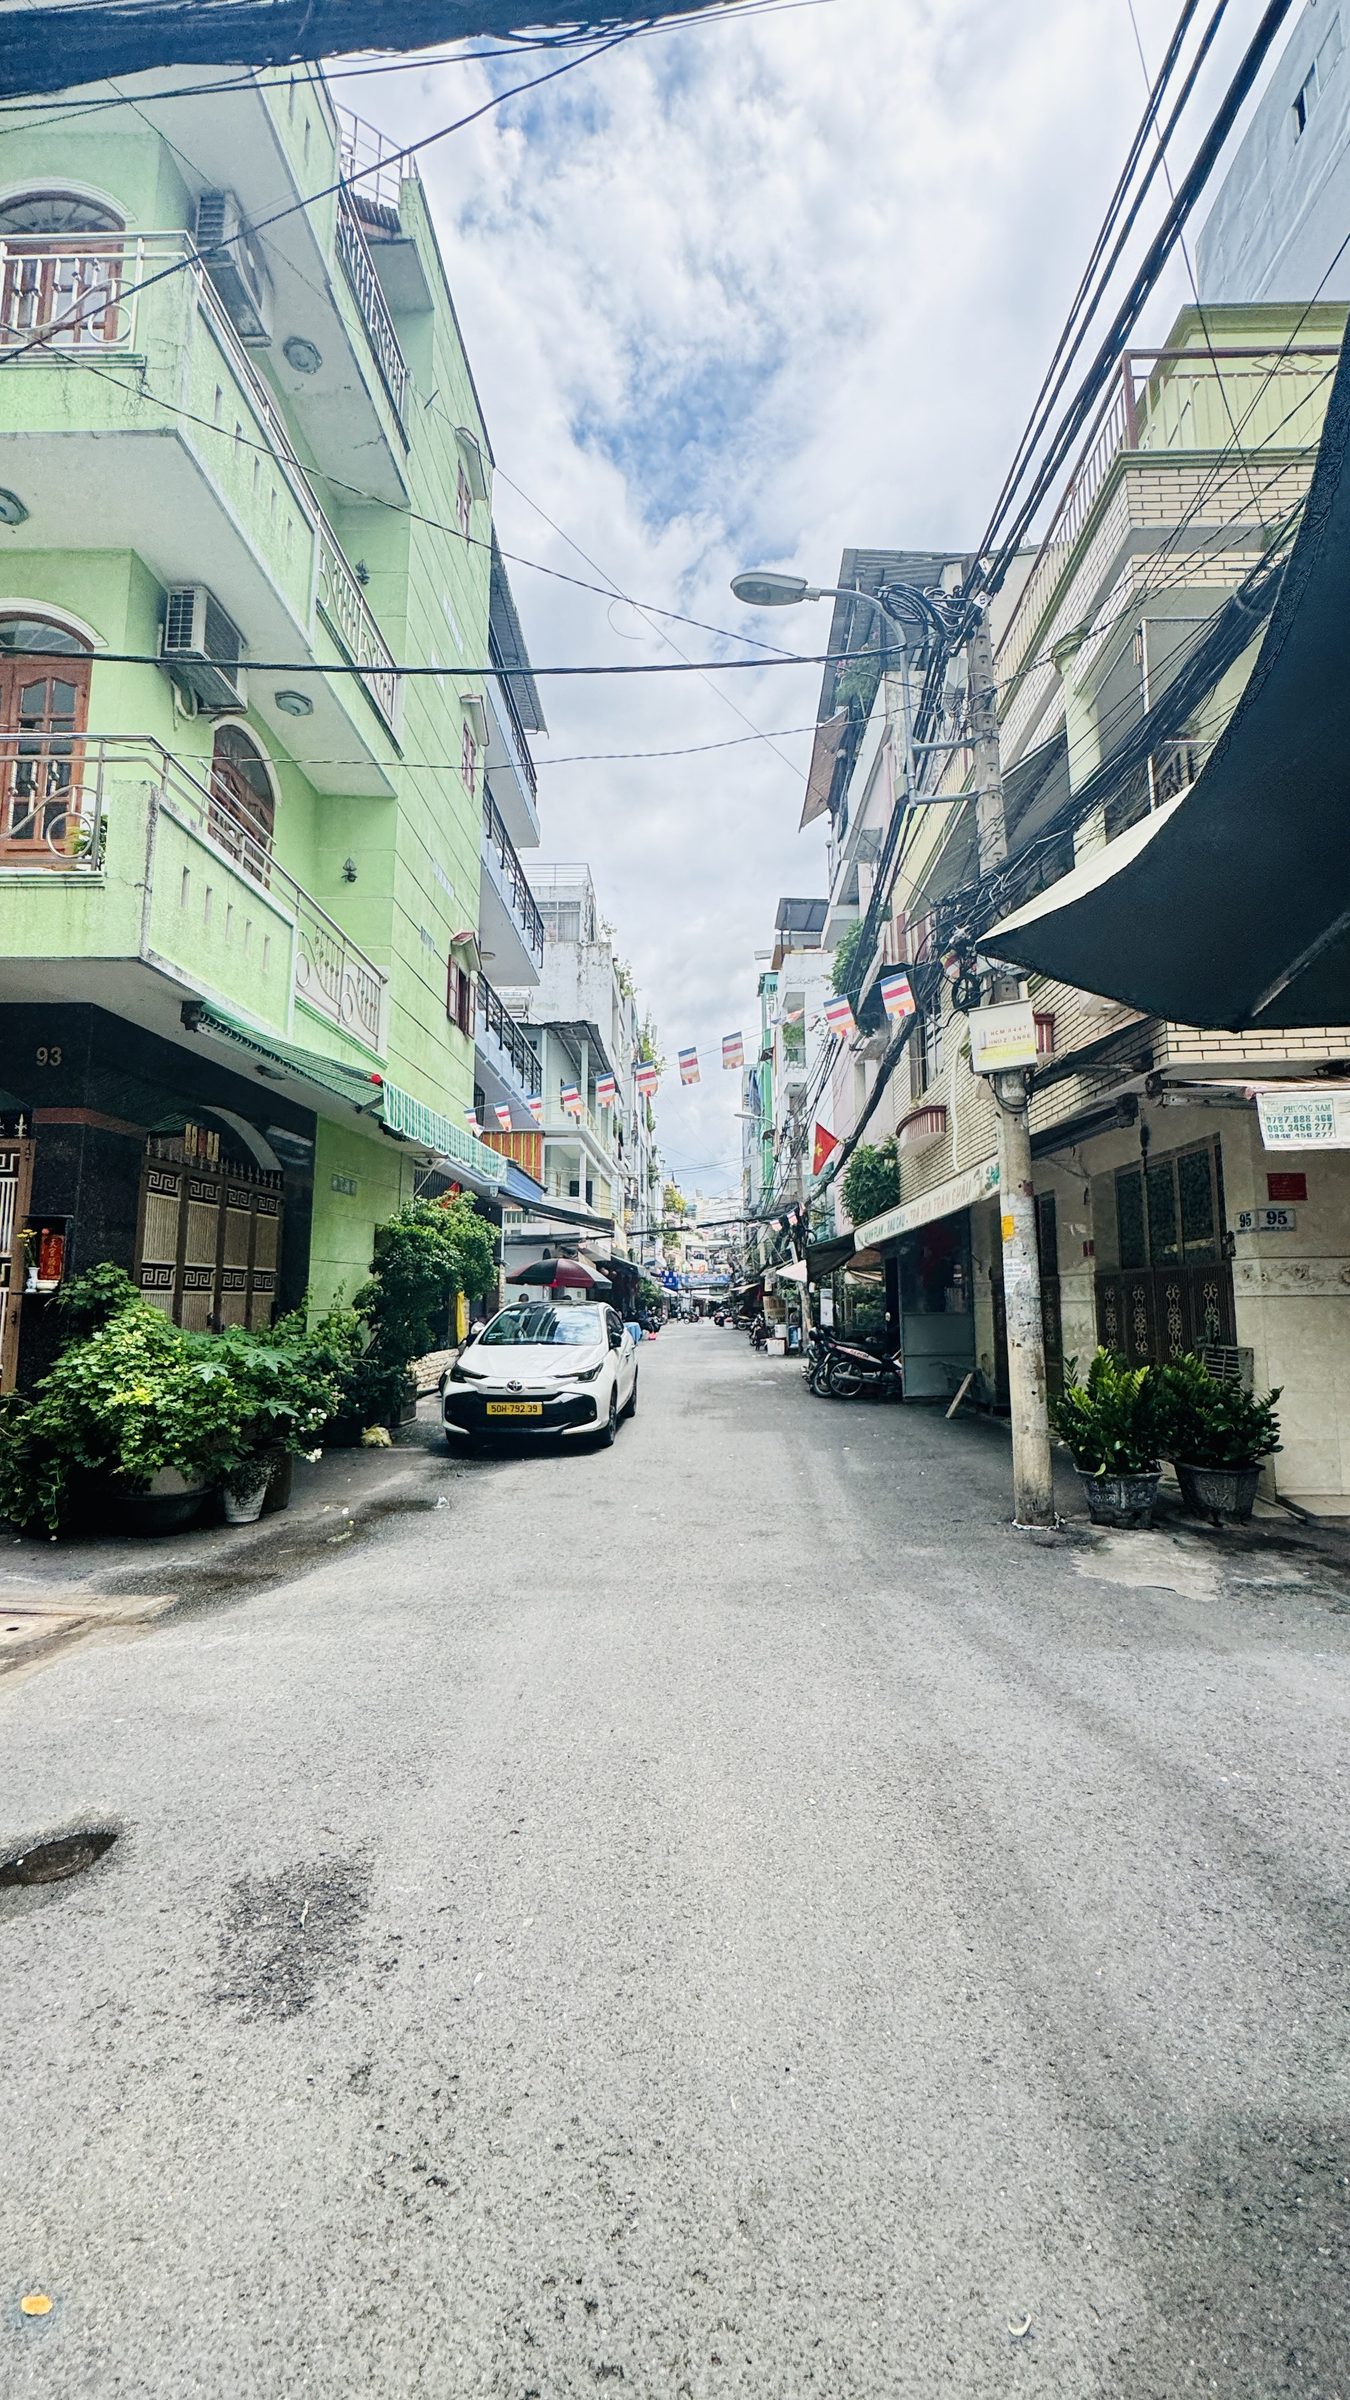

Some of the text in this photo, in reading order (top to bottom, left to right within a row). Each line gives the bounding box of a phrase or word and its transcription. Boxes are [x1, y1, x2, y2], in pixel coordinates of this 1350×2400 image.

[36, 1046, 62, 1067] 93
[1239, 1212, 1252, 1228] 95
[1266, 1210, 1288, 1225] 95
